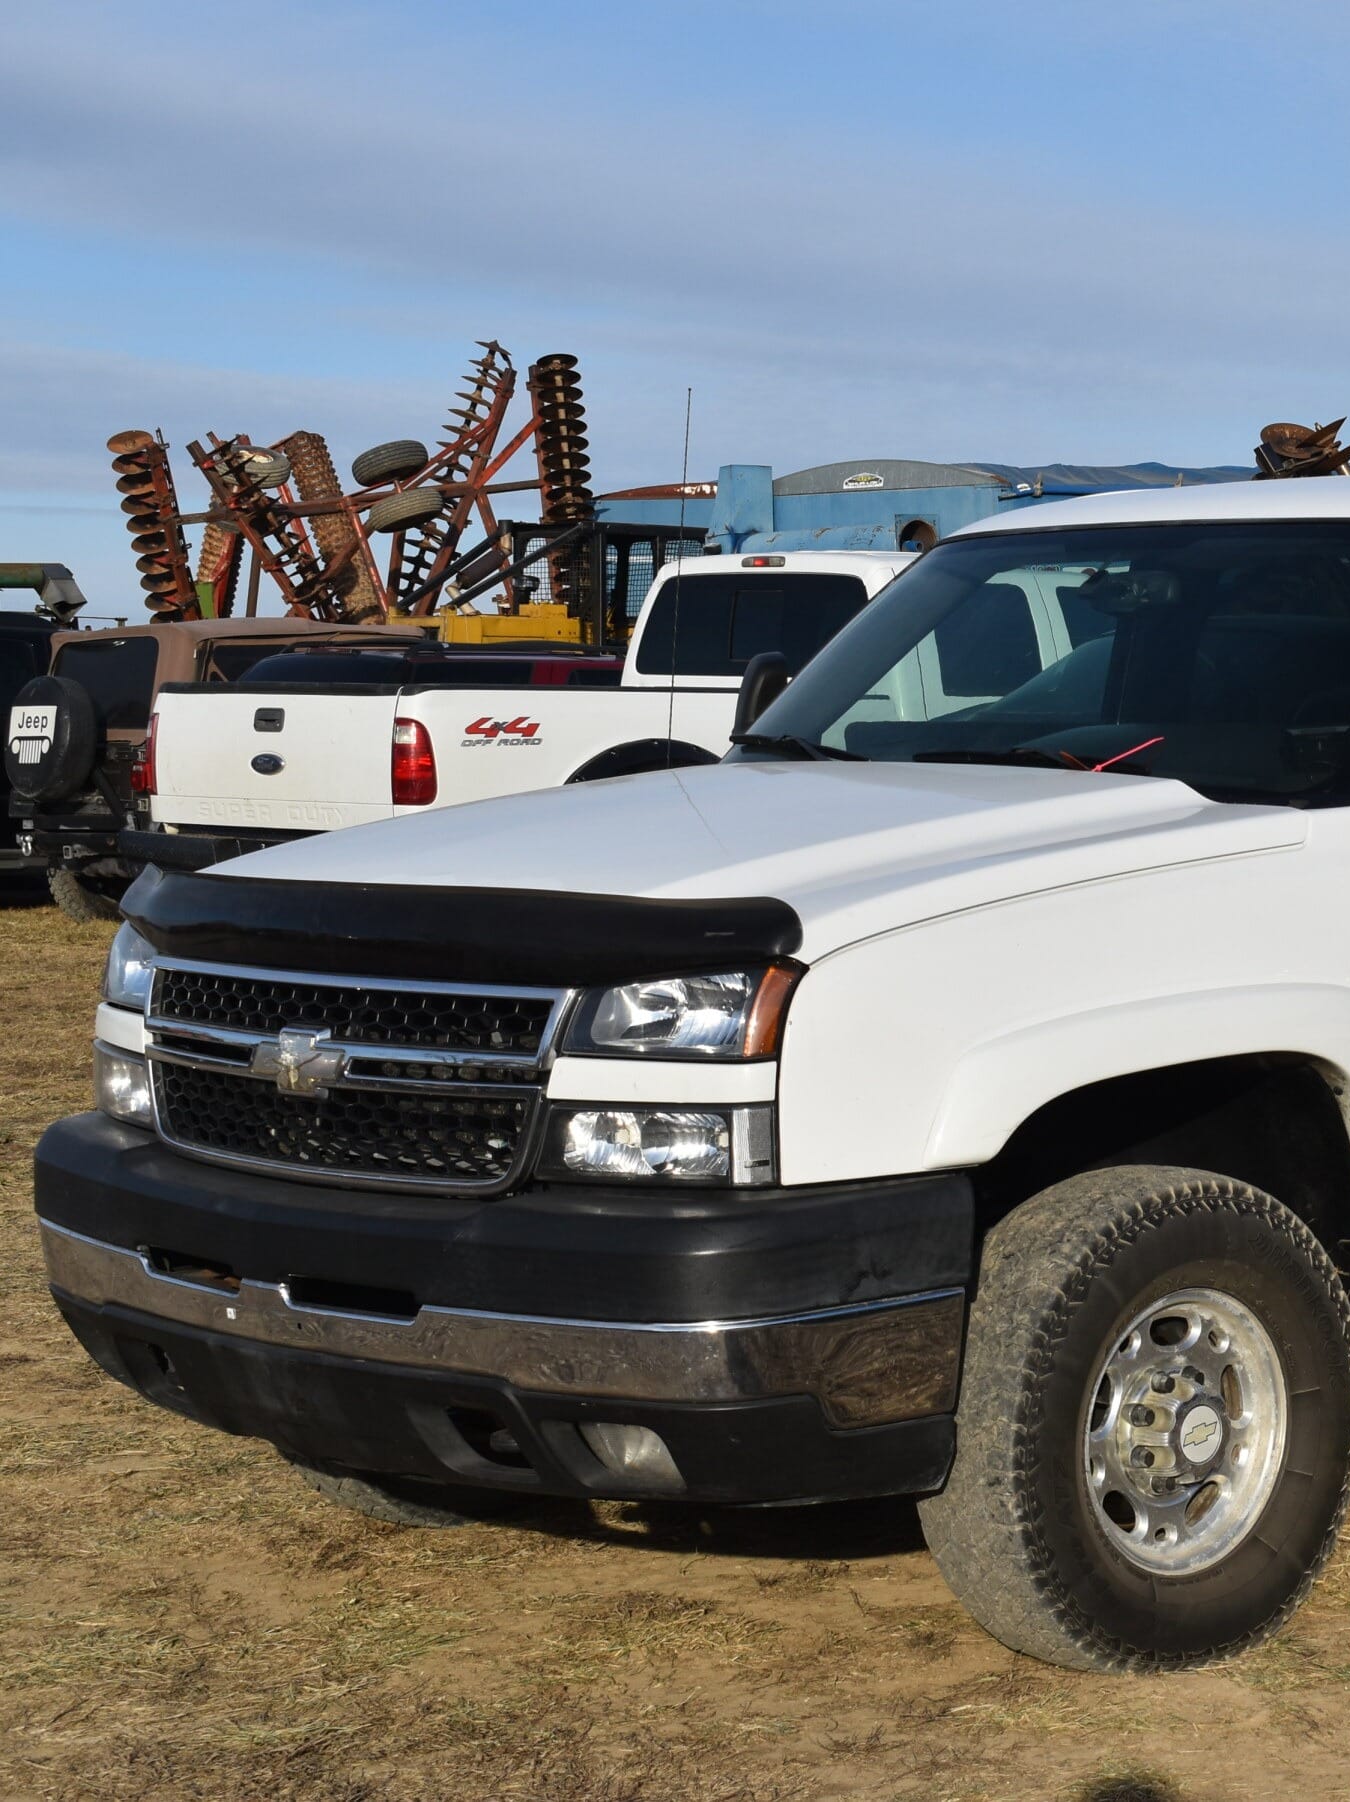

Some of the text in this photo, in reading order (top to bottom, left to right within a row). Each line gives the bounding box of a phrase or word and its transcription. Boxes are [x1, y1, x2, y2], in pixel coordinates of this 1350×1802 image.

[18, 711, 48, 733] Jeep
[461, 738, 543, 748] OFF ROAD
[199, 801, 347, 826] SUPER DUTY
